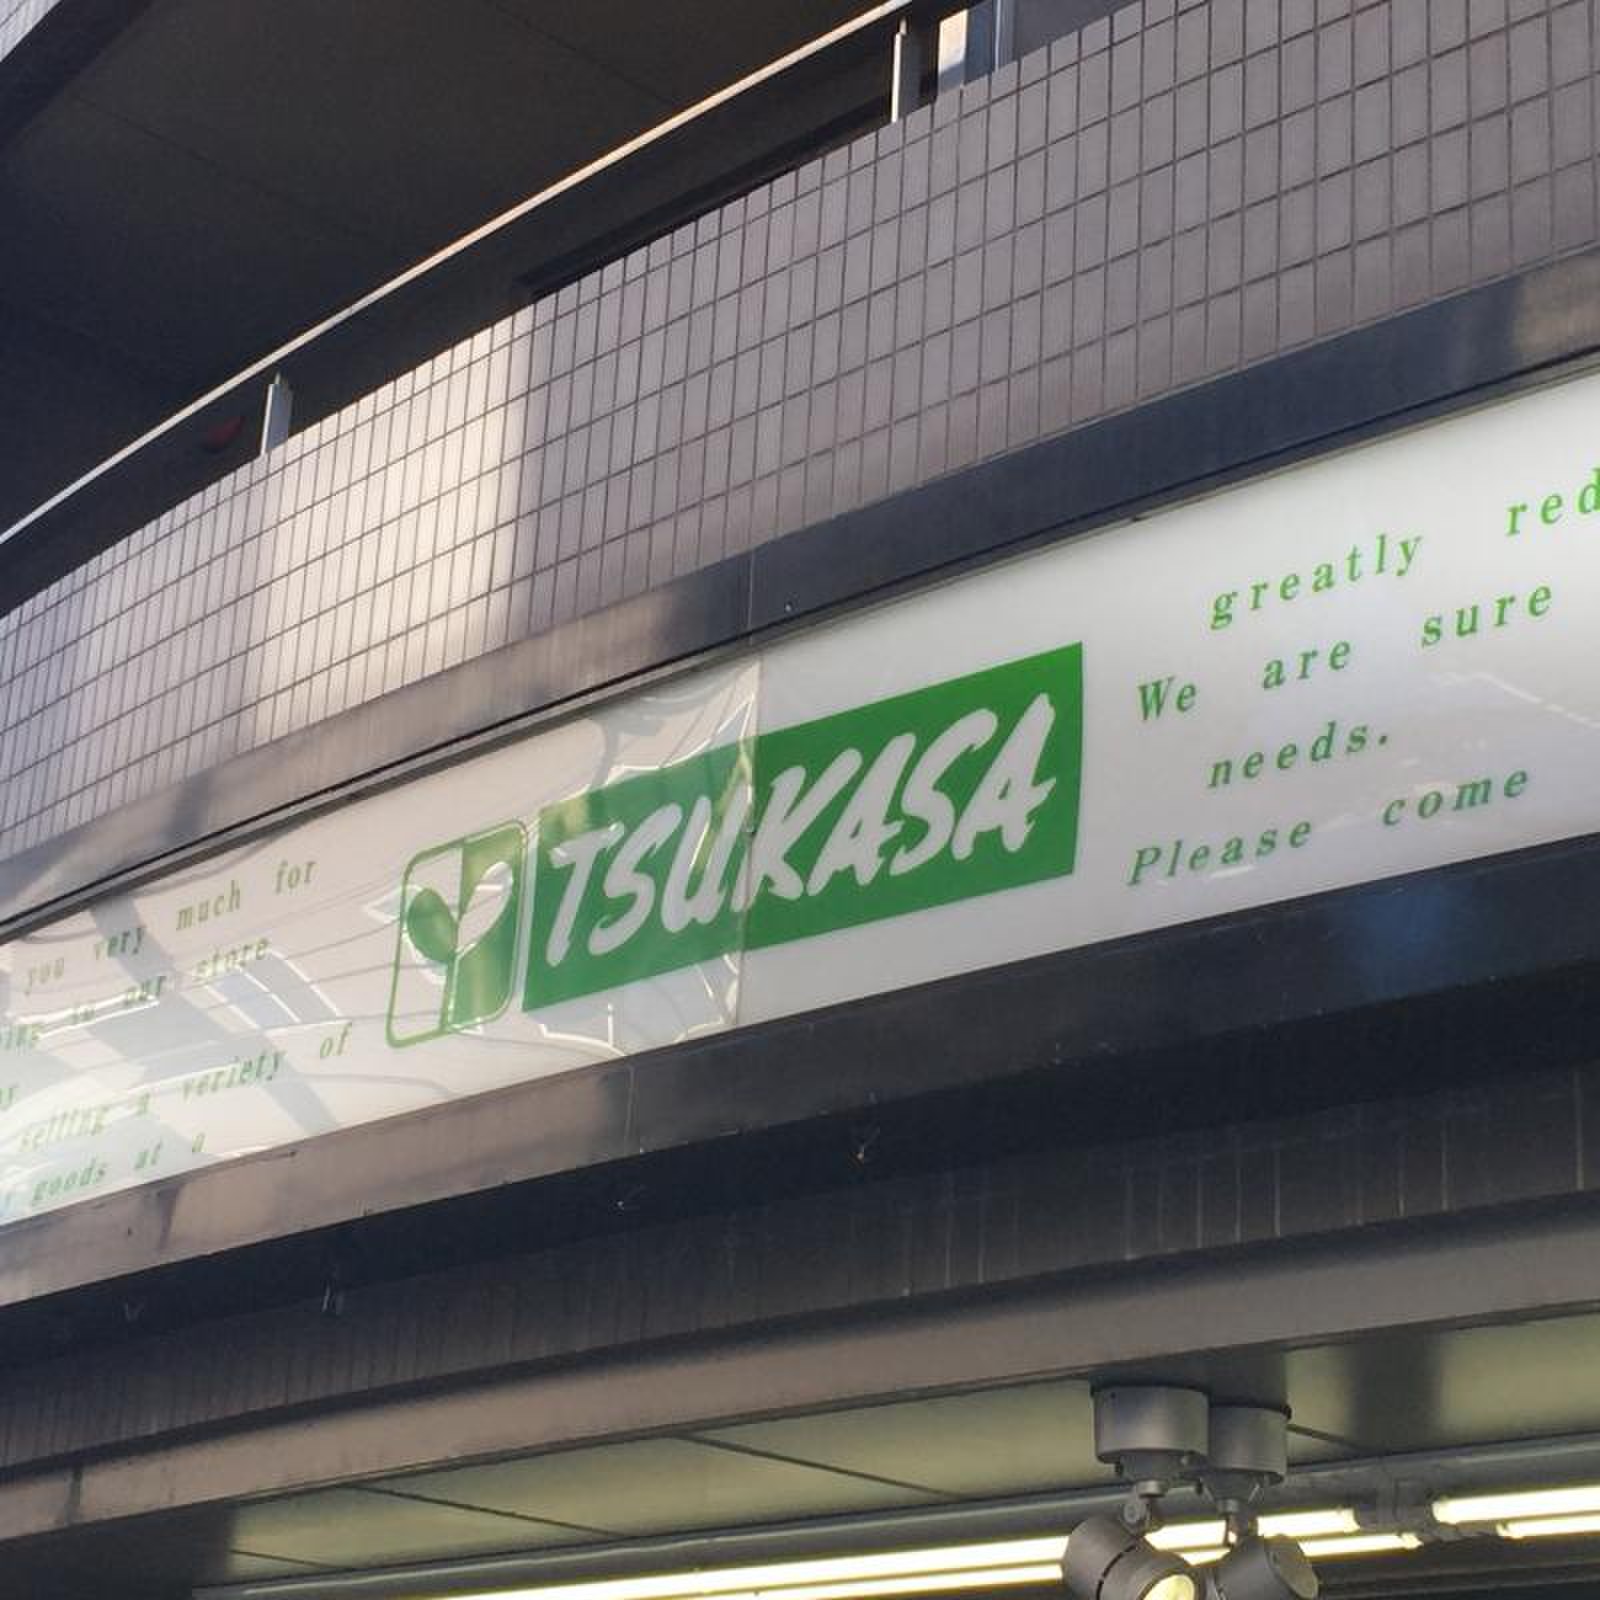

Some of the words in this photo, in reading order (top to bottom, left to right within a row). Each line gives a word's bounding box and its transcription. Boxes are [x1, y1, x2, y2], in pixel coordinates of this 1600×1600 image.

[1209, 533, 1423, 630] greatly
[1136, 676, 1198, 721] We
[1262, 641, 1352, 689] are
[1420, 585, 1553, 647] sure
[1208, 722, 1389, 788] needs.
[546, 692, 1057, 968] TSUKASA
[1128, 820, 1313, 887] Please
[1383, 769, 1529, 827] come
[176, 879, 242, 931] much
[275, 859, 318, 895] for
[194, 936, 270, 982] store
[319, 1021, 353, 1060] of
